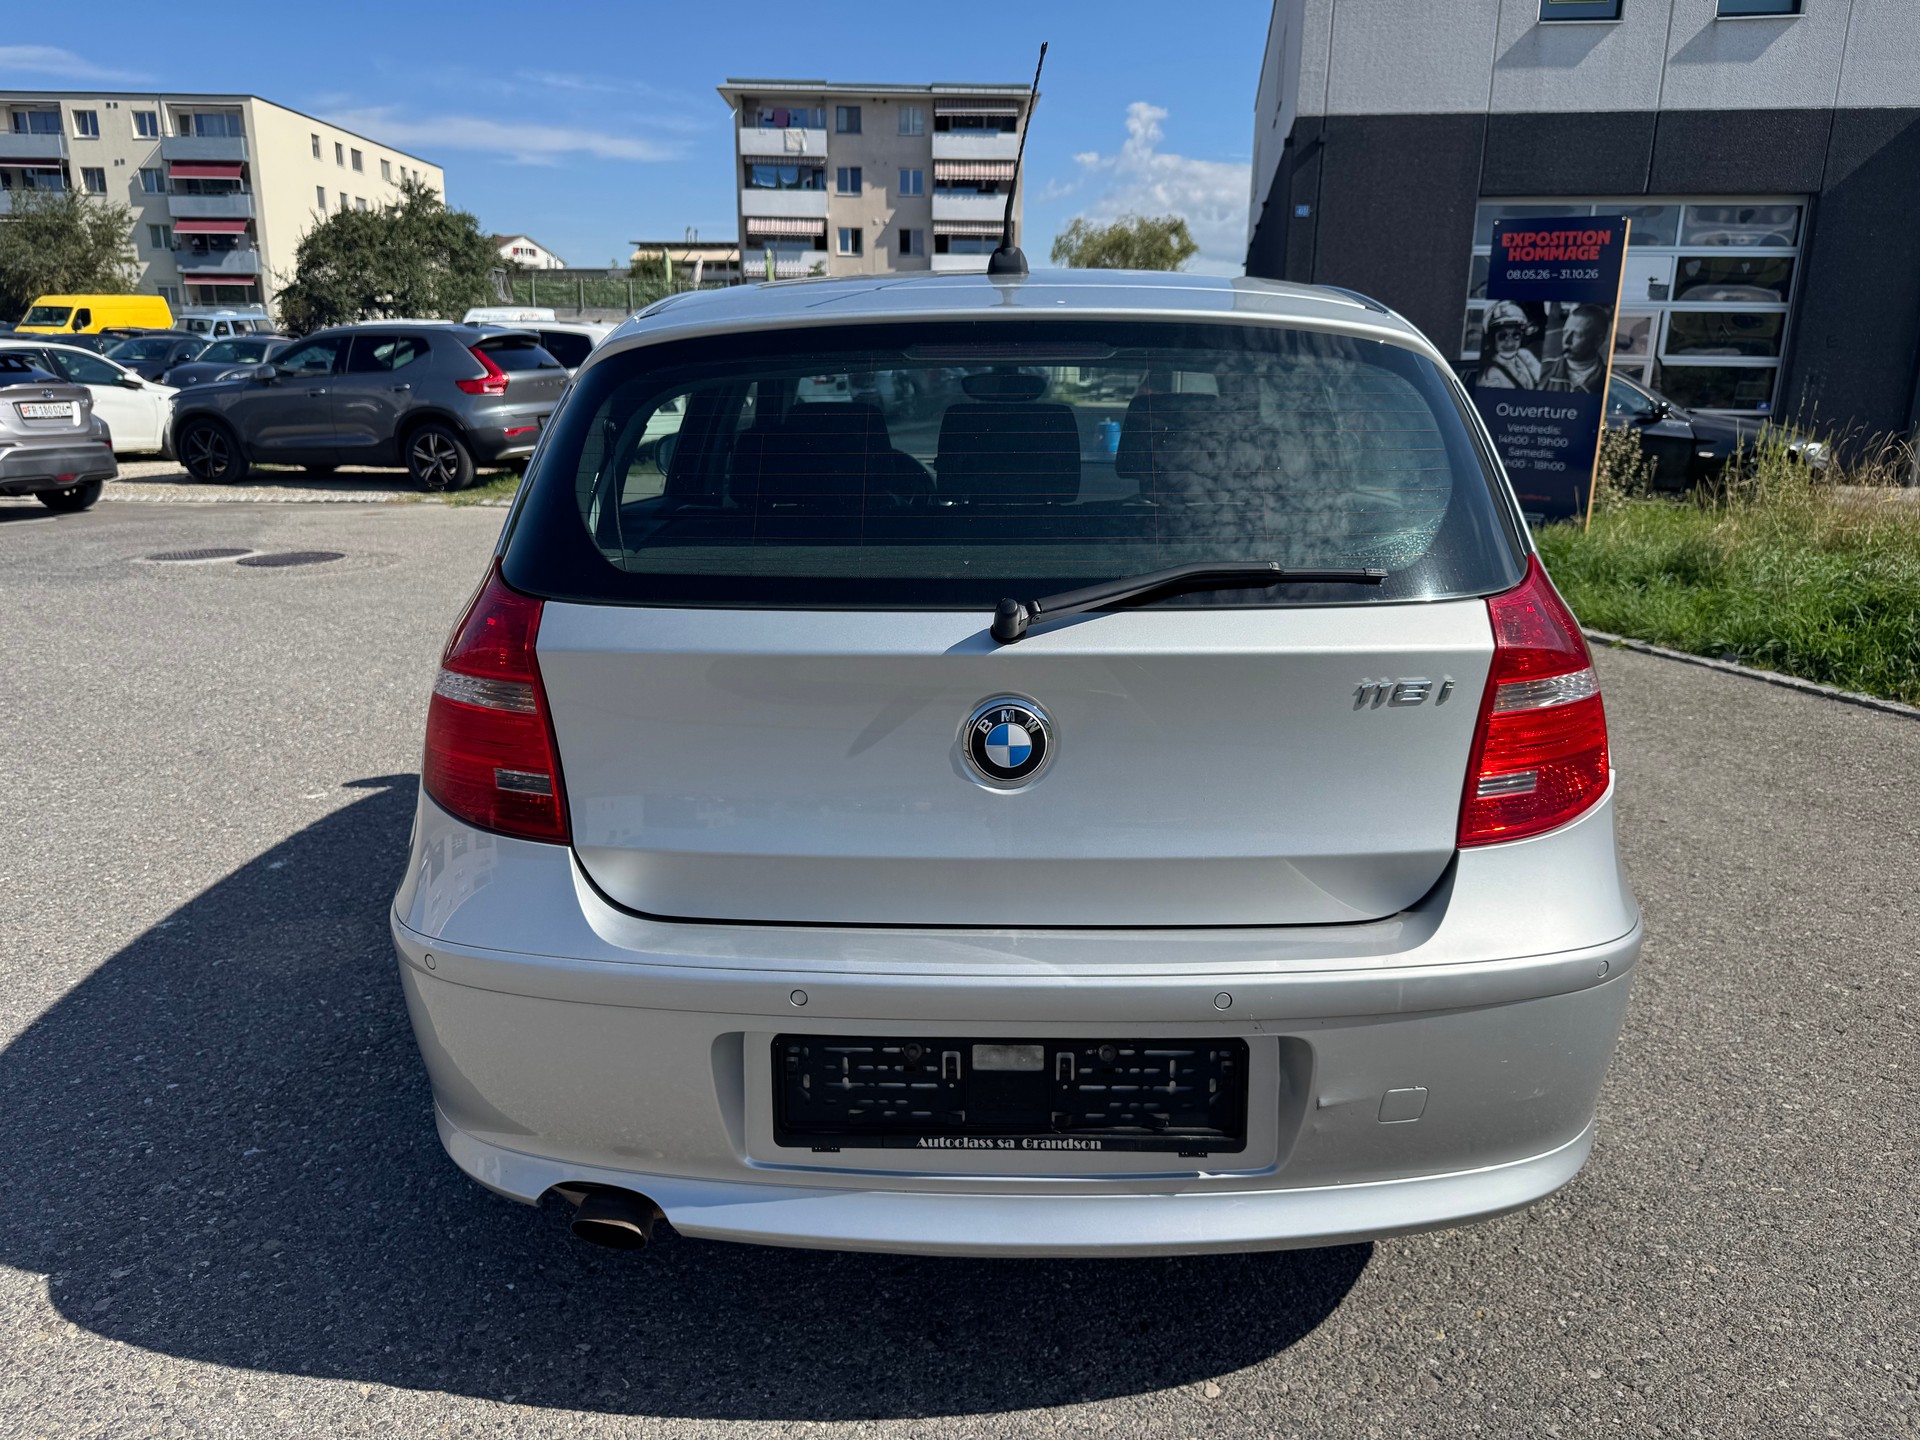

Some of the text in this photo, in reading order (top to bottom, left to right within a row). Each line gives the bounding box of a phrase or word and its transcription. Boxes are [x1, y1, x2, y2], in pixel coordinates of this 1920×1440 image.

[1502, 231, 1611, 247] EXPOSITION
[1508, 246, 1599, 261] HOMMAGE
[1506, 269, 1550, 280] 08.05.26
[1559, 268, 1599, 279] 31.10.26
[1496, 403, 1578, 420] Ouverture
[977, 710, 1041, 734] BMW
[916, 1136, 1102, 1150] Autoclass sa Grandson
